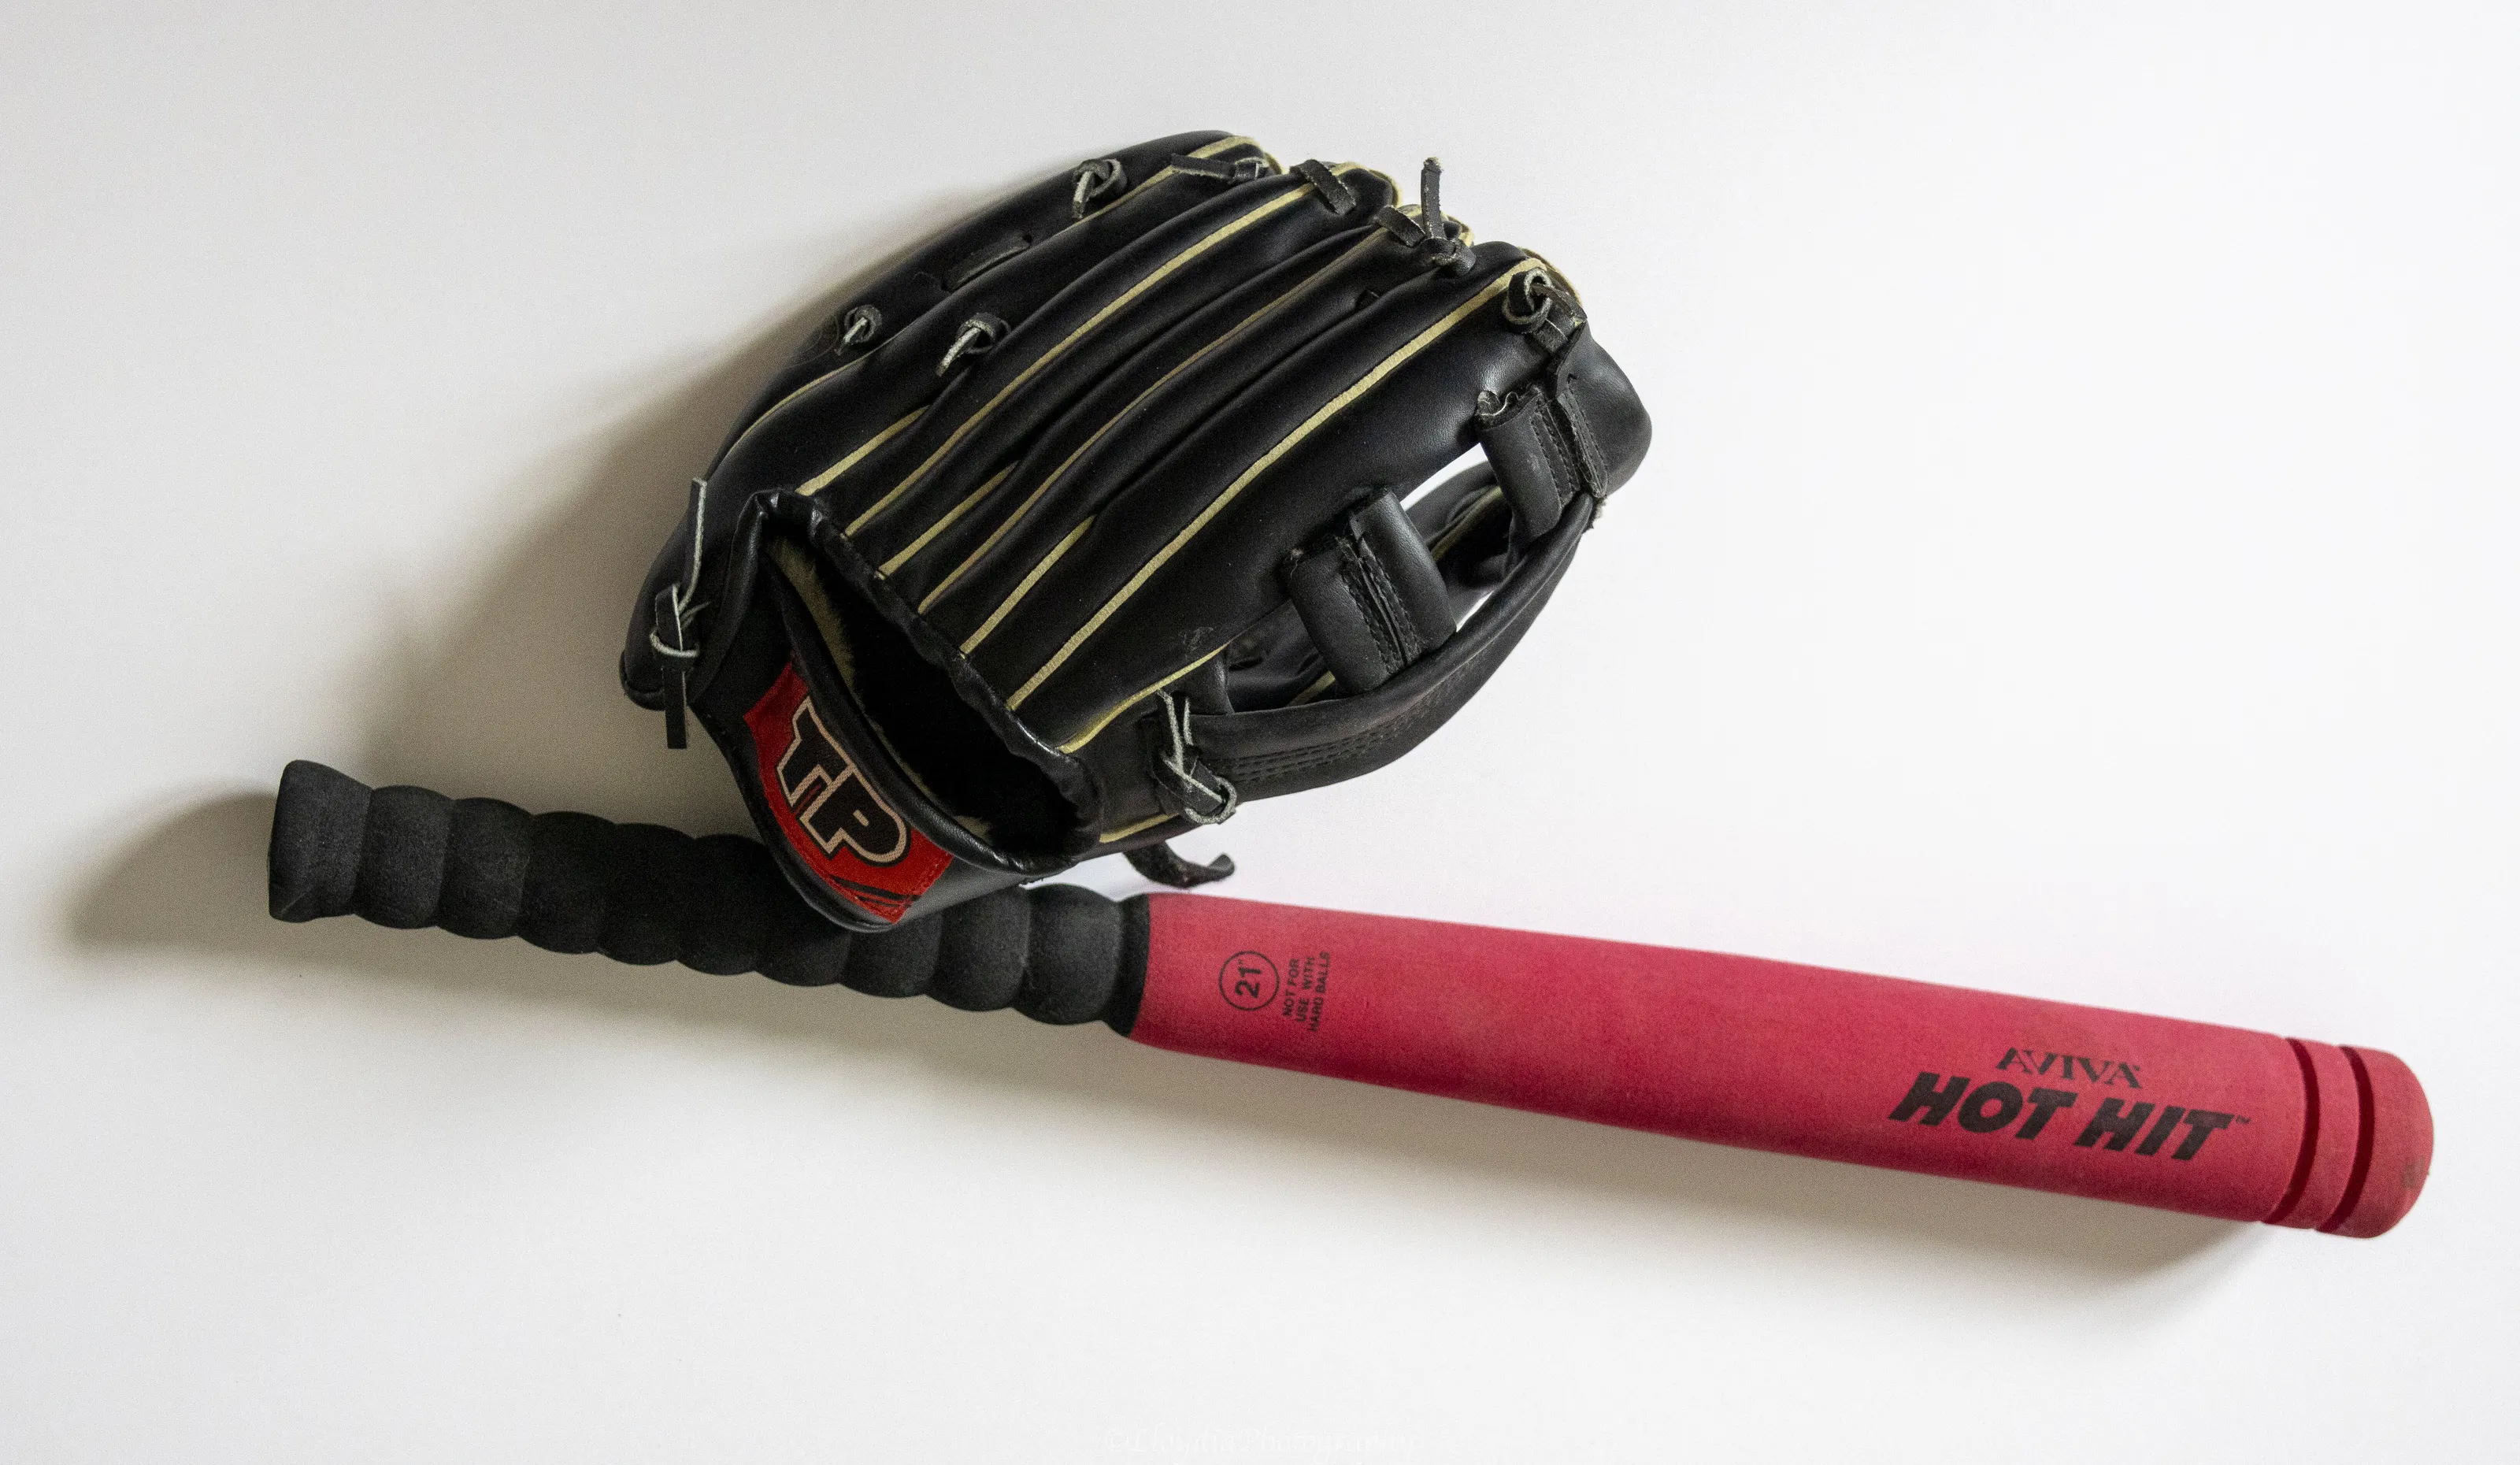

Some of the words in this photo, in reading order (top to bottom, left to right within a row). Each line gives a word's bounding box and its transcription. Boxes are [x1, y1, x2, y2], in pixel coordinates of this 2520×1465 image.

[1287, 959, 1299, 987] FOR
[1302, 956, 1315, 990] WITH
[1315, 951, 1330, 993] BALLS
[1283, 989, 1295, 1016] NOT
[1296, 997, 1309, 1022] USE
[1307, 996, 1324, 1032] HARD
[1996, 1047, 2143, 1089] AVIVA
[1888, 1071, 2077, 1140] HOT
